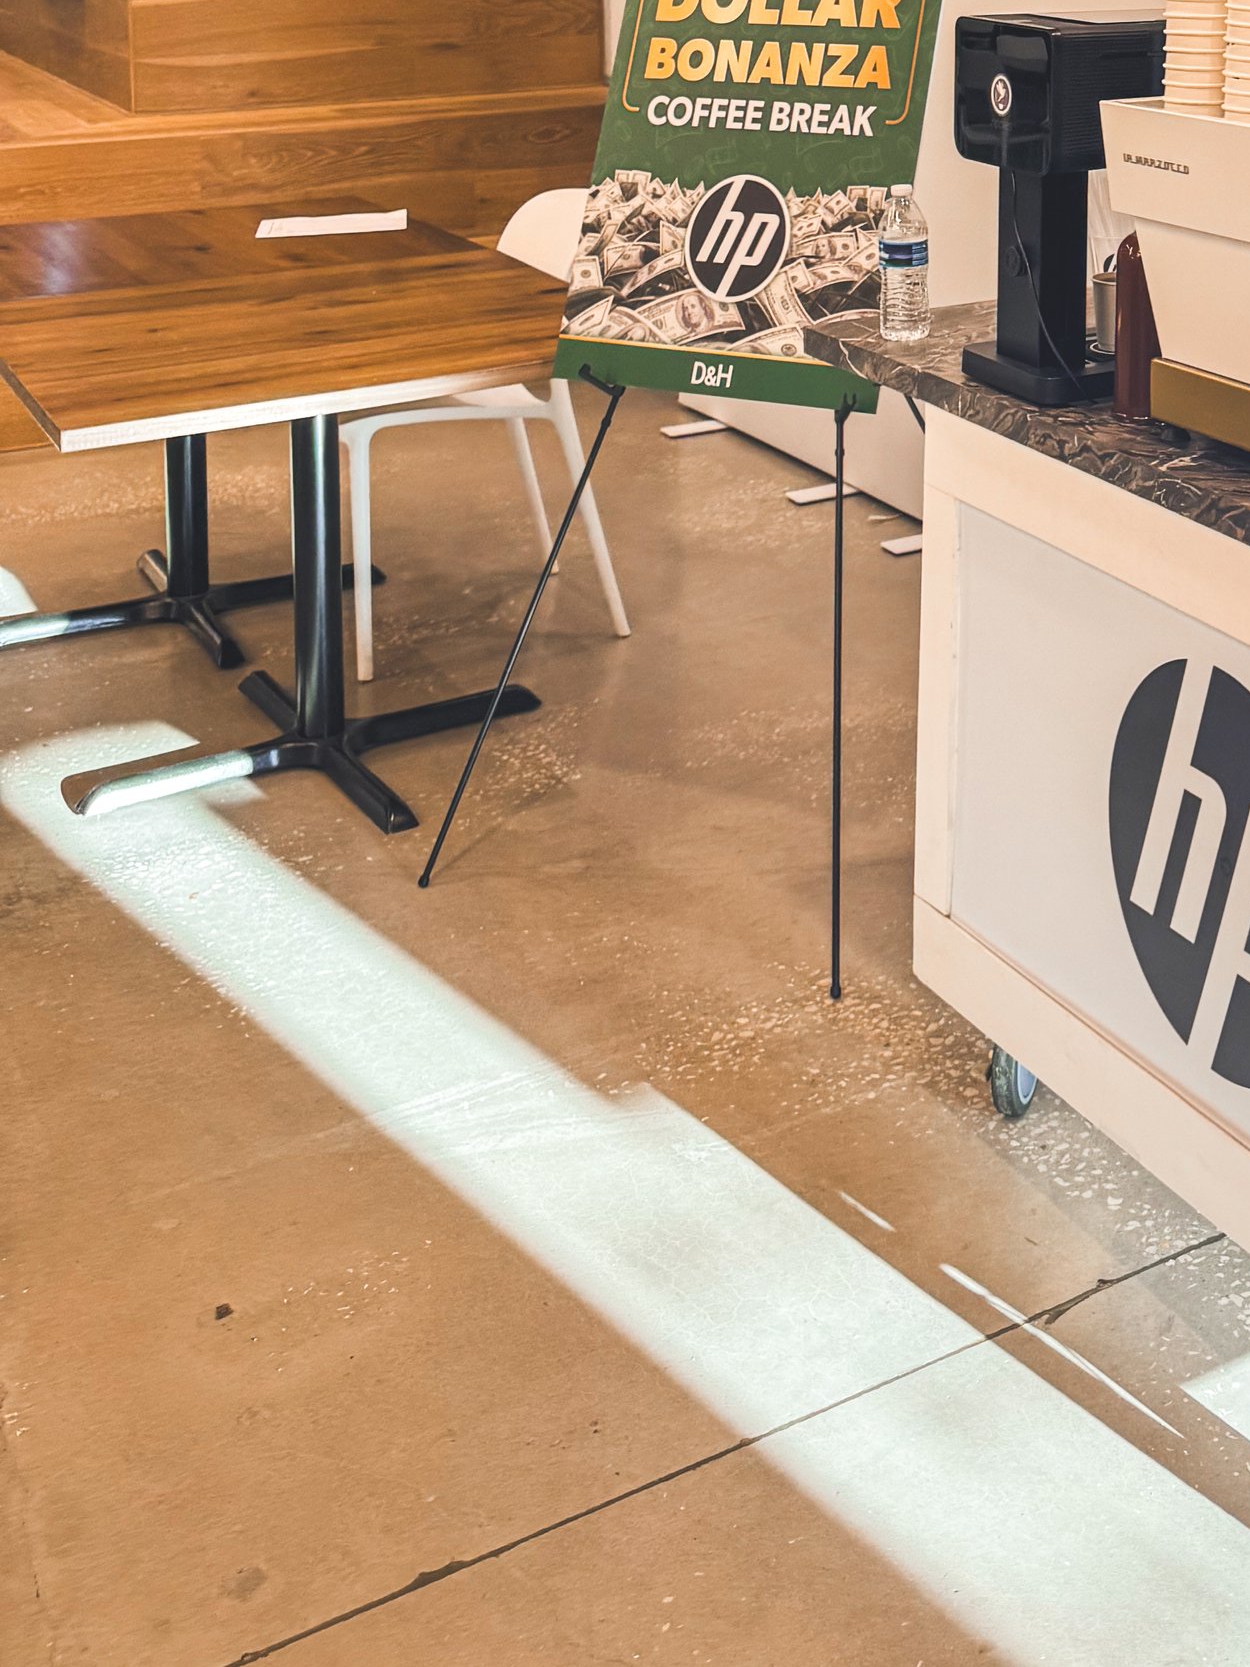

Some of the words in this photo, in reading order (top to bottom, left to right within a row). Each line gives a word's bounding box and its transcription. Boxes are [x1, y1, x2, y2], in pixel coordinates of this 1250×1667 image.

[643, 37, 891, 90] BONANZA
[646, 95, 763, 132] COFFEE
[769, 100, 877, 137] BREAK
[695, 177, 781, 298] hp
[689, 361, 735, 389] D&H
